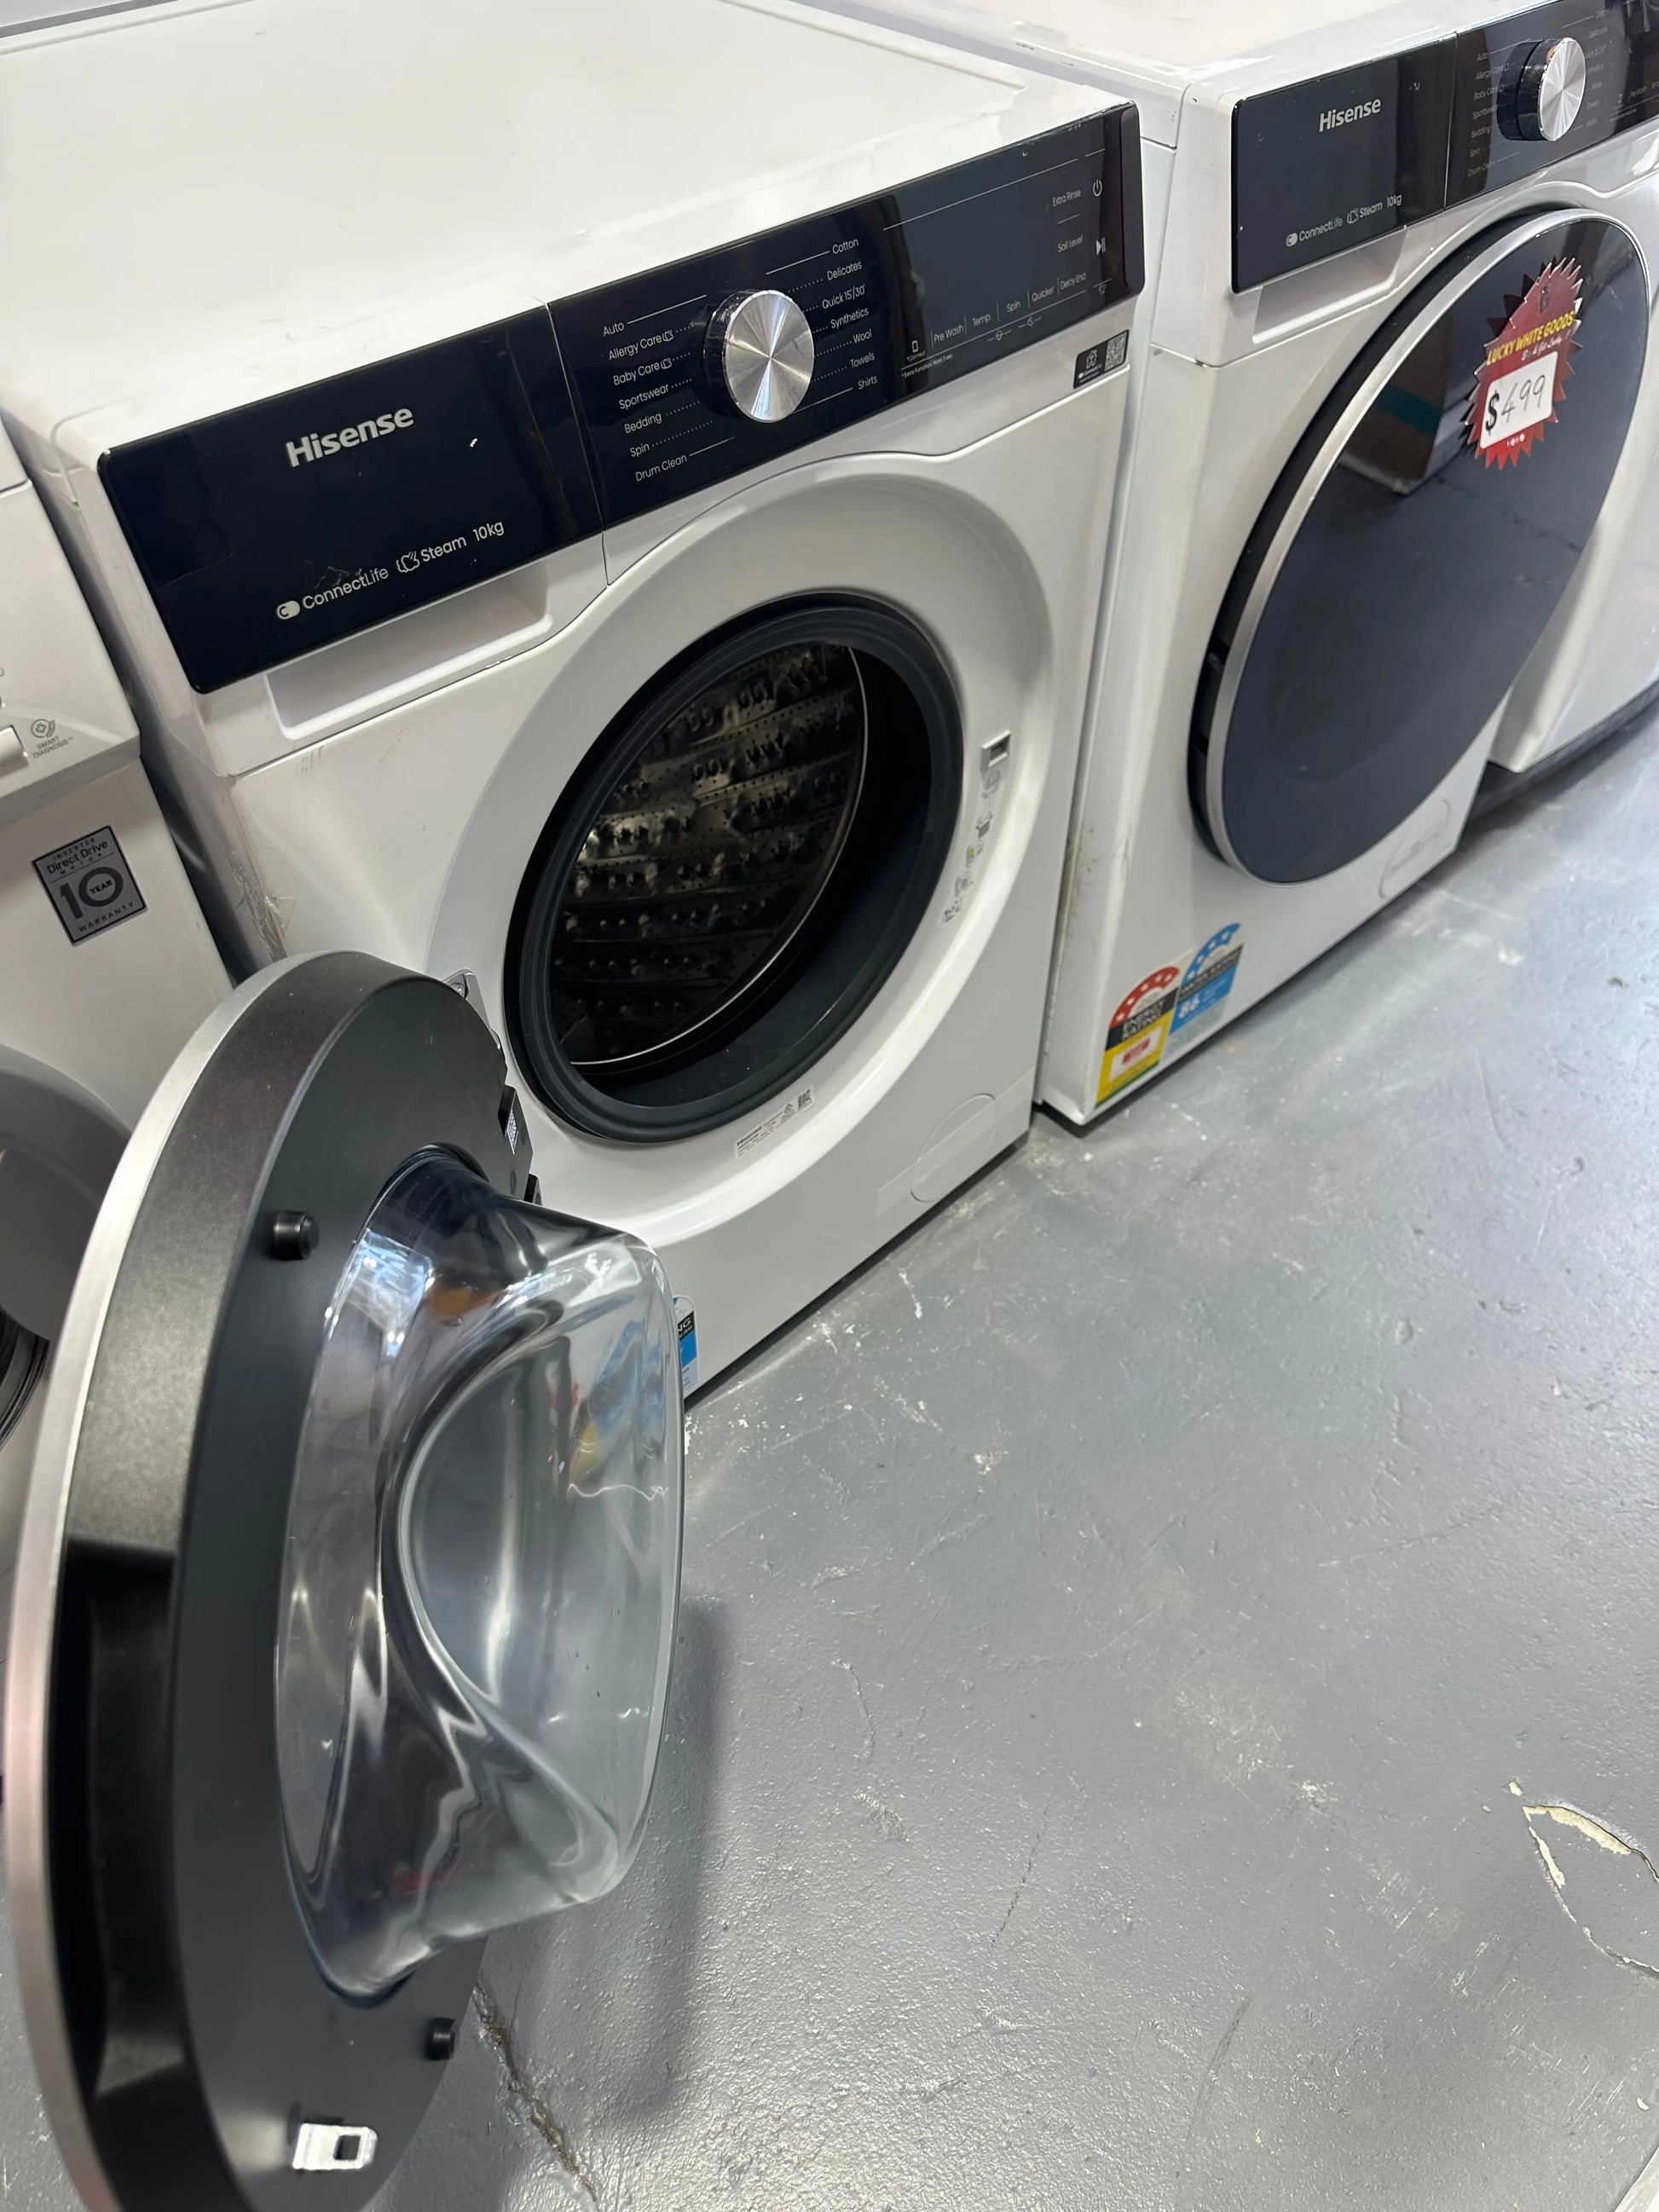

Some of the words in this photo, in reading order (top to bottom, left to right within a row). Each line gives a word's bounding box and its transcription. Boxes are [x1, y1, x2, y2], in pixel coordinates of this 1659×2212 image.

[1319, 98, 1382, 132] Hisense
[1052, 192, 1066, 207] Extra
[1066, 188, 1081, 203] Rinse
[1298, 217, 1344, 241] ConnectLife
[1359, 201, 1383, 218] Steam
[1386, 194, 1402, 208] 10kg
[832, 238, 859, 255] Cotton
[1058, 240, 1069, 252] Soil
[826, 260, 862, 281] Delicates
[822, 292, 844, 309] Quick
[830, 307, 870, 330] Synthetics
[934, 332, 945, 344] Pre
[945, 323, 964, 338] Wash
[1006, 300, 1020, 315] Spin
[1032, 285, 1055, 303] Quicker
[603, 321, 625, 338] Auto
[853, 328, 873, 344] Wool
[1486, 338, 1516, 367] LUCKY
[1515, 325, 1544, 351] WHITE
[1543, 310, 1575, 338] GOODS
[608, 340, 639, 361] Allergy
[639, 334, 662, 350] Care
[850, 352, 876, 369] Towels
[613, 367, 637, 386] Baby
[637, 362, 661, 378] Care
[858, 375, 878, 390] Shirts
[619, 383, 670, 410] Sportswear
[1485, 374, 1546, 436] $499
[624, 411, 662, 435] Bedding
[286, 407, 414, 467] Hisense
[630, 442, 650, 459] Spin
[635, 464, 661, 482] Drum
[661, 454, 687, 472] Clean
[303, 566, 389, 609] ConnectLife
[420, 535, 467, 563] Steam
[473, 521, 505, 541] 10kg
[37, 736, 60, 750] SMART
[47, 852, 80, 875] Direct
[80, 840, 108, 858] Drive
[60, 866, 124, 920] 10
[89, 880, 113, 895] YEAR
[78, 902, 134, 932] WARRANTY
